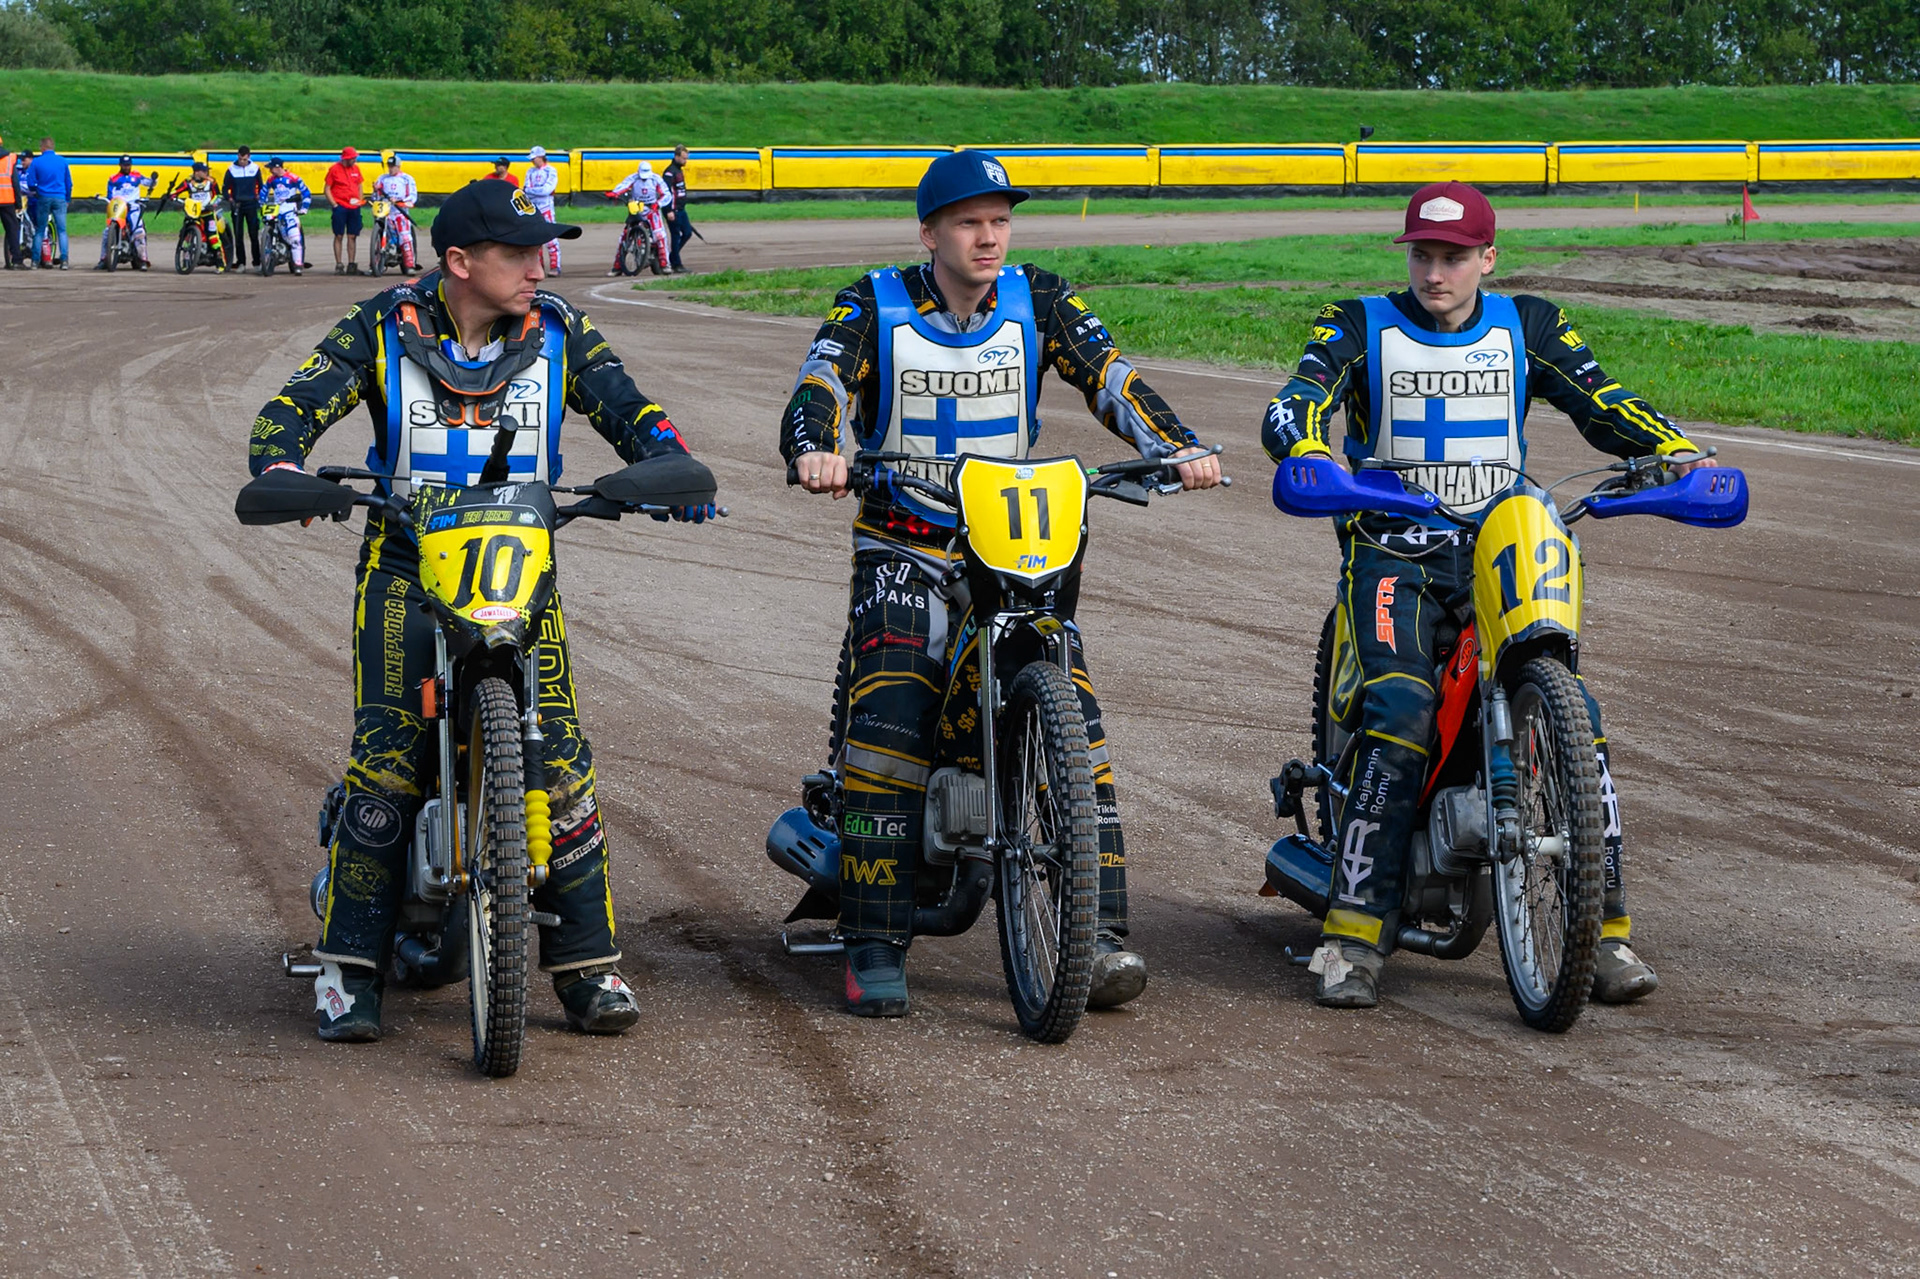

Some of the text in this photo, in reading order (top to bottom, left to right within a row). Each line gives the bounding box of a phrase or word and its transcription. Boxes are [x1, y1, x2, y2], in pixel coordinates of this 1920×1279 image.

[191, 203, 198, 215] 4
[376, 203, 384, 214] 3
[901, 367, 1020, 396] SUOMI
[1390, 369, 1510, 396] SUOMI
[429, 514, 457, 530] FIM
[1000, 487, 1051, 541] 11
[452, 534, 527, 610] 10
[1015, 555, 1047, 569] FIM
[1491, 537, 1571, 620] 12
[855, 590, 925, 618] HYPAKS
[1376, 575, 1400, 655] SPTR
[1355, 747, 1382, 811] Kajaanin
[1370, 772, 1391, 814] Romu
[844, 813, 907, 837] EduTec
[1604, 846, 1616, 889] Romu
